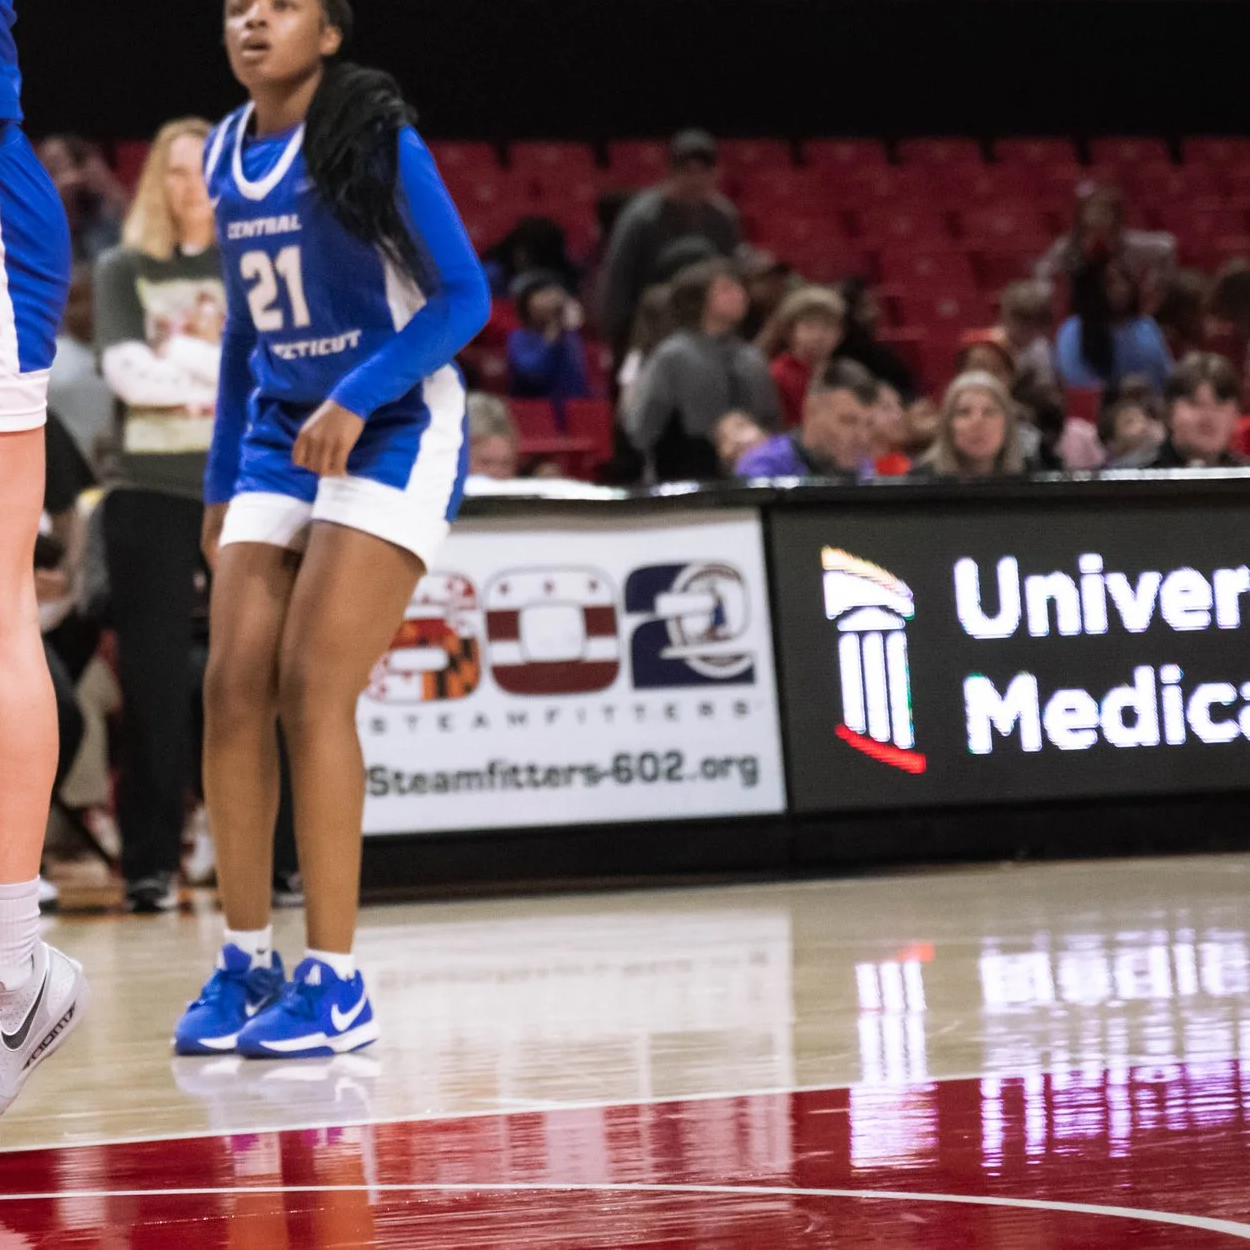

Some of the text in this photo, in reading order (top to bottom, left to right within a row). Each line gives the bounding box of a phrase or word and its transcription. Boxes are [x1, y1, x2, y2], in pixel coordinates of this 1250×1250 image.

[227, 213, 302, 240] CENTRAL
[240, 244, 310, 332] 21
[953, 553, 1250, 640] Univer
[369, 700, 753, 734] STEAMFITTERS
[368, 749, 759, 797] Steamfitters-602.org
